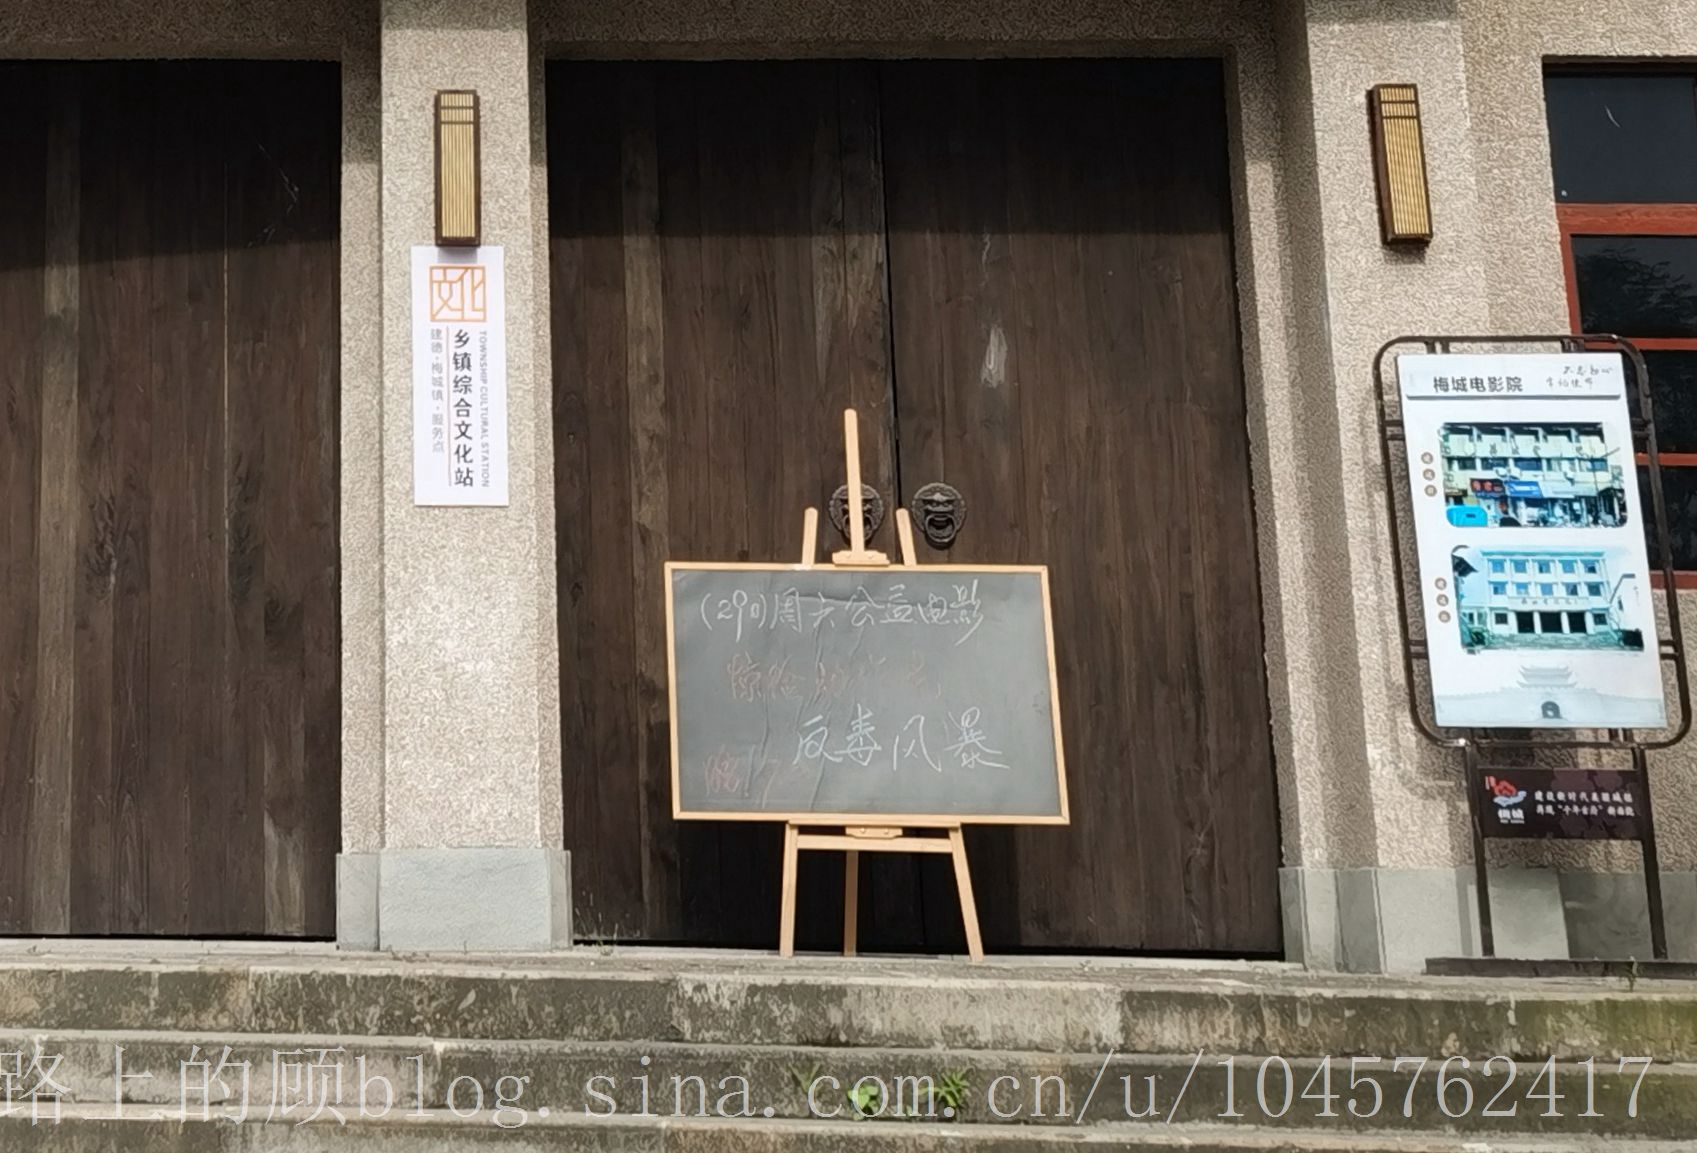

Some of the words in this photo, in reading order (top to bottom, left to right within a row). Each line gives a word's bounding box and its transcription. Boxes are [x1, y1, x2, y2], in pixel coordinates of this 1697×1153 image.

[479, 330, 488, 385] TOWNSHIP
[1433, 376, 1524, 393] 梅城电影院
[452, 328, 474, 488] 乡镇综合文化站
[480, 386, 489, 440] CULTURAL
[481, 441, 490, 488] STATION
